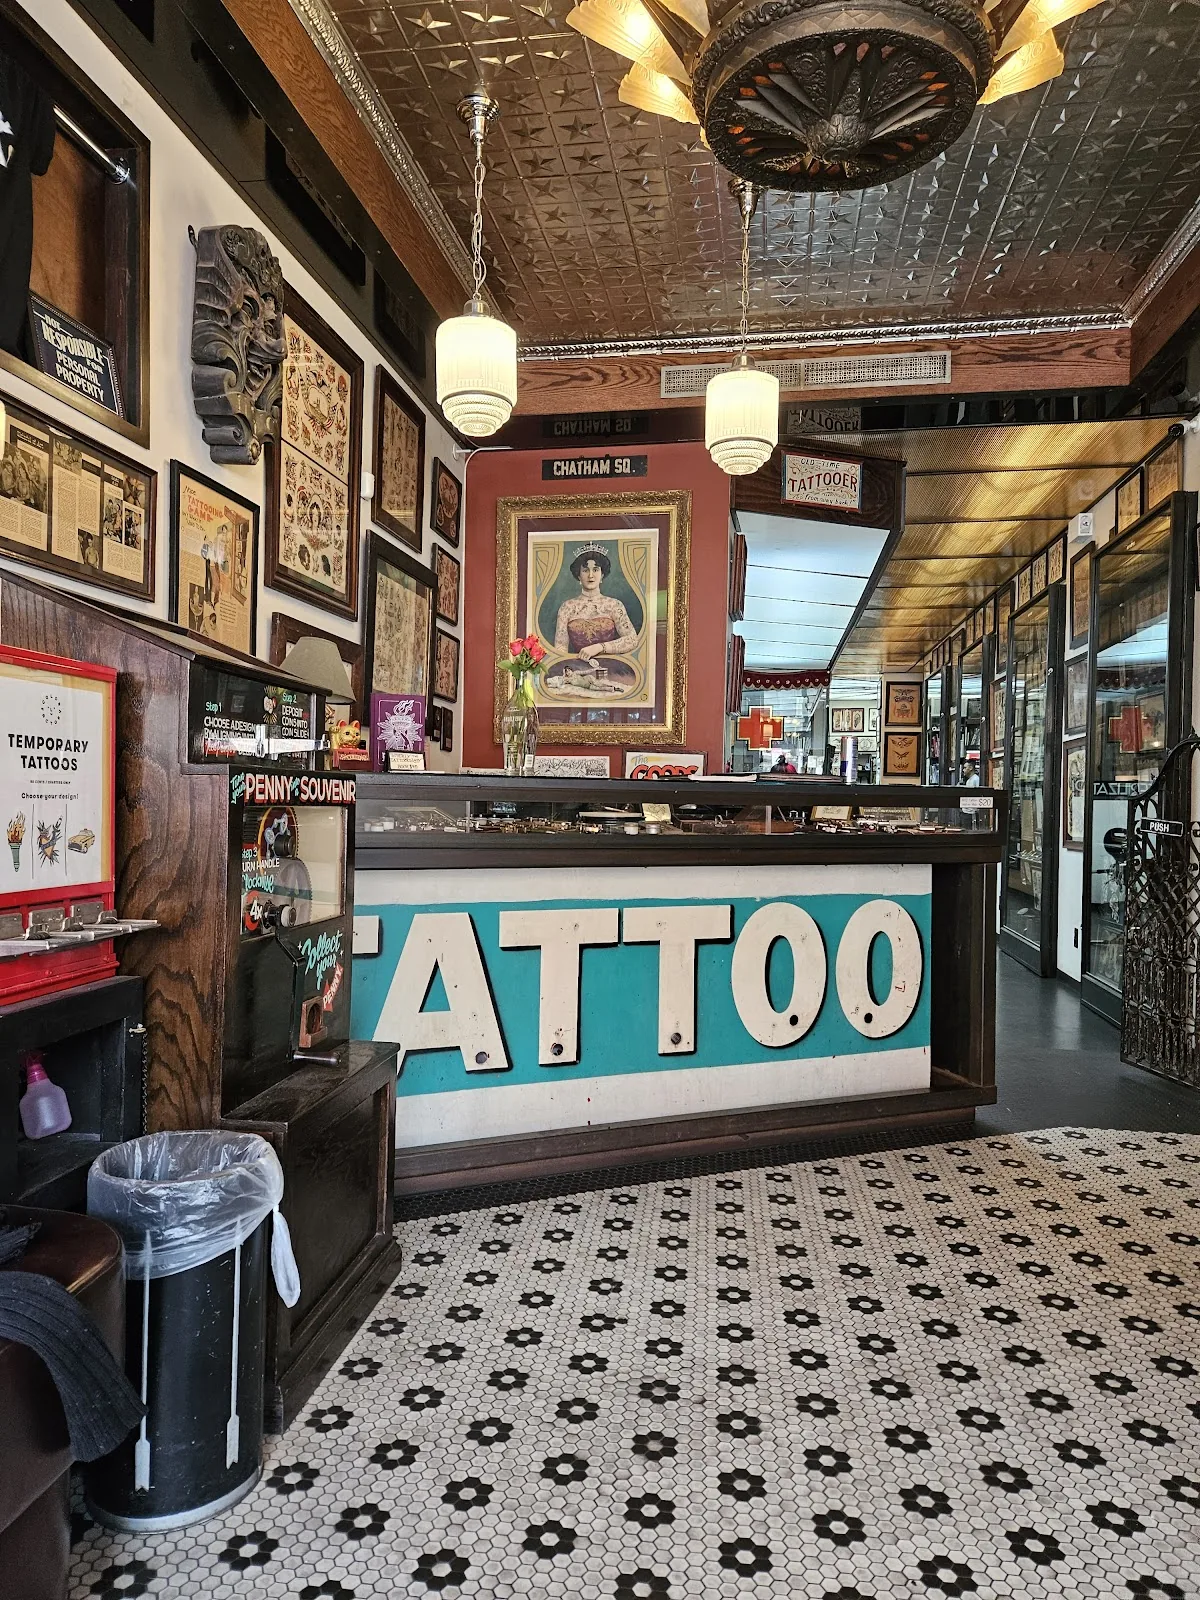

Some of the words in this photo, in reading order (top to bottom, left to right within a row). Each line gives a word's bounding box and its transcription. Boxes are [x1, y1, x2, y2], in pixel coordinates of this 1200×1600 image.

[45, 314, 61, 331] NOT
[41, 319, 105, 366] RESPONSIBLE
[56, 350, 102, 387] PERSONAL
[86, 359, 104, 374] FOR
[55, 363, 104, 402] PROPERTY
[553, 460, 610, 476] CHATHAM
[614, 458, 636, 474] SQ.
[800, 458, 815, 466] OLD
[788, 472, 858, 493] TATTOOER
[187, 494, 224, 519] TATTOOING
[282, 692, 294, 705] Step
[293, 694, 298, 704] 2
[205, 701, 219, 714] Step
[218, 702, 222, 713] 1
[281, 705, 304, 718] DEPOSIT
[204, 716, 231, 730] CHOOSE
[235, 721, 256, 733] DESIGN
[281, 716, 296, 729] COINS
[295, 719, 308, 729] INTO
[204, 728, 212, 739] BY
[281, 727, 294, 737] COIN
[8, 733, 89, 753] TEMPORARY
[20, 755, 78, 771] TATTOOS
[631, 754, 649, 766] The
[230, 781, 247, 805] your
[244, 773, 293, 803] PENNY
[300, 774, 357, 803] SOUVENIR
[21, 792, 43, 800] Choose
[44, 793, 58, 801] your
[58, 793, 79, 801] design!
[978, 798, 993, 808] $20
[1150, 821, 1170, 833] PUSH
[252, 846, 258, 857] 3
[242, 861, 255, 873] URN
[256, 858, 280, 870] HANDLE
[249, 899, 264, 921] 4x
[316, 954, 338, 991] your
[322, 965, 344, 1009] PENNY
